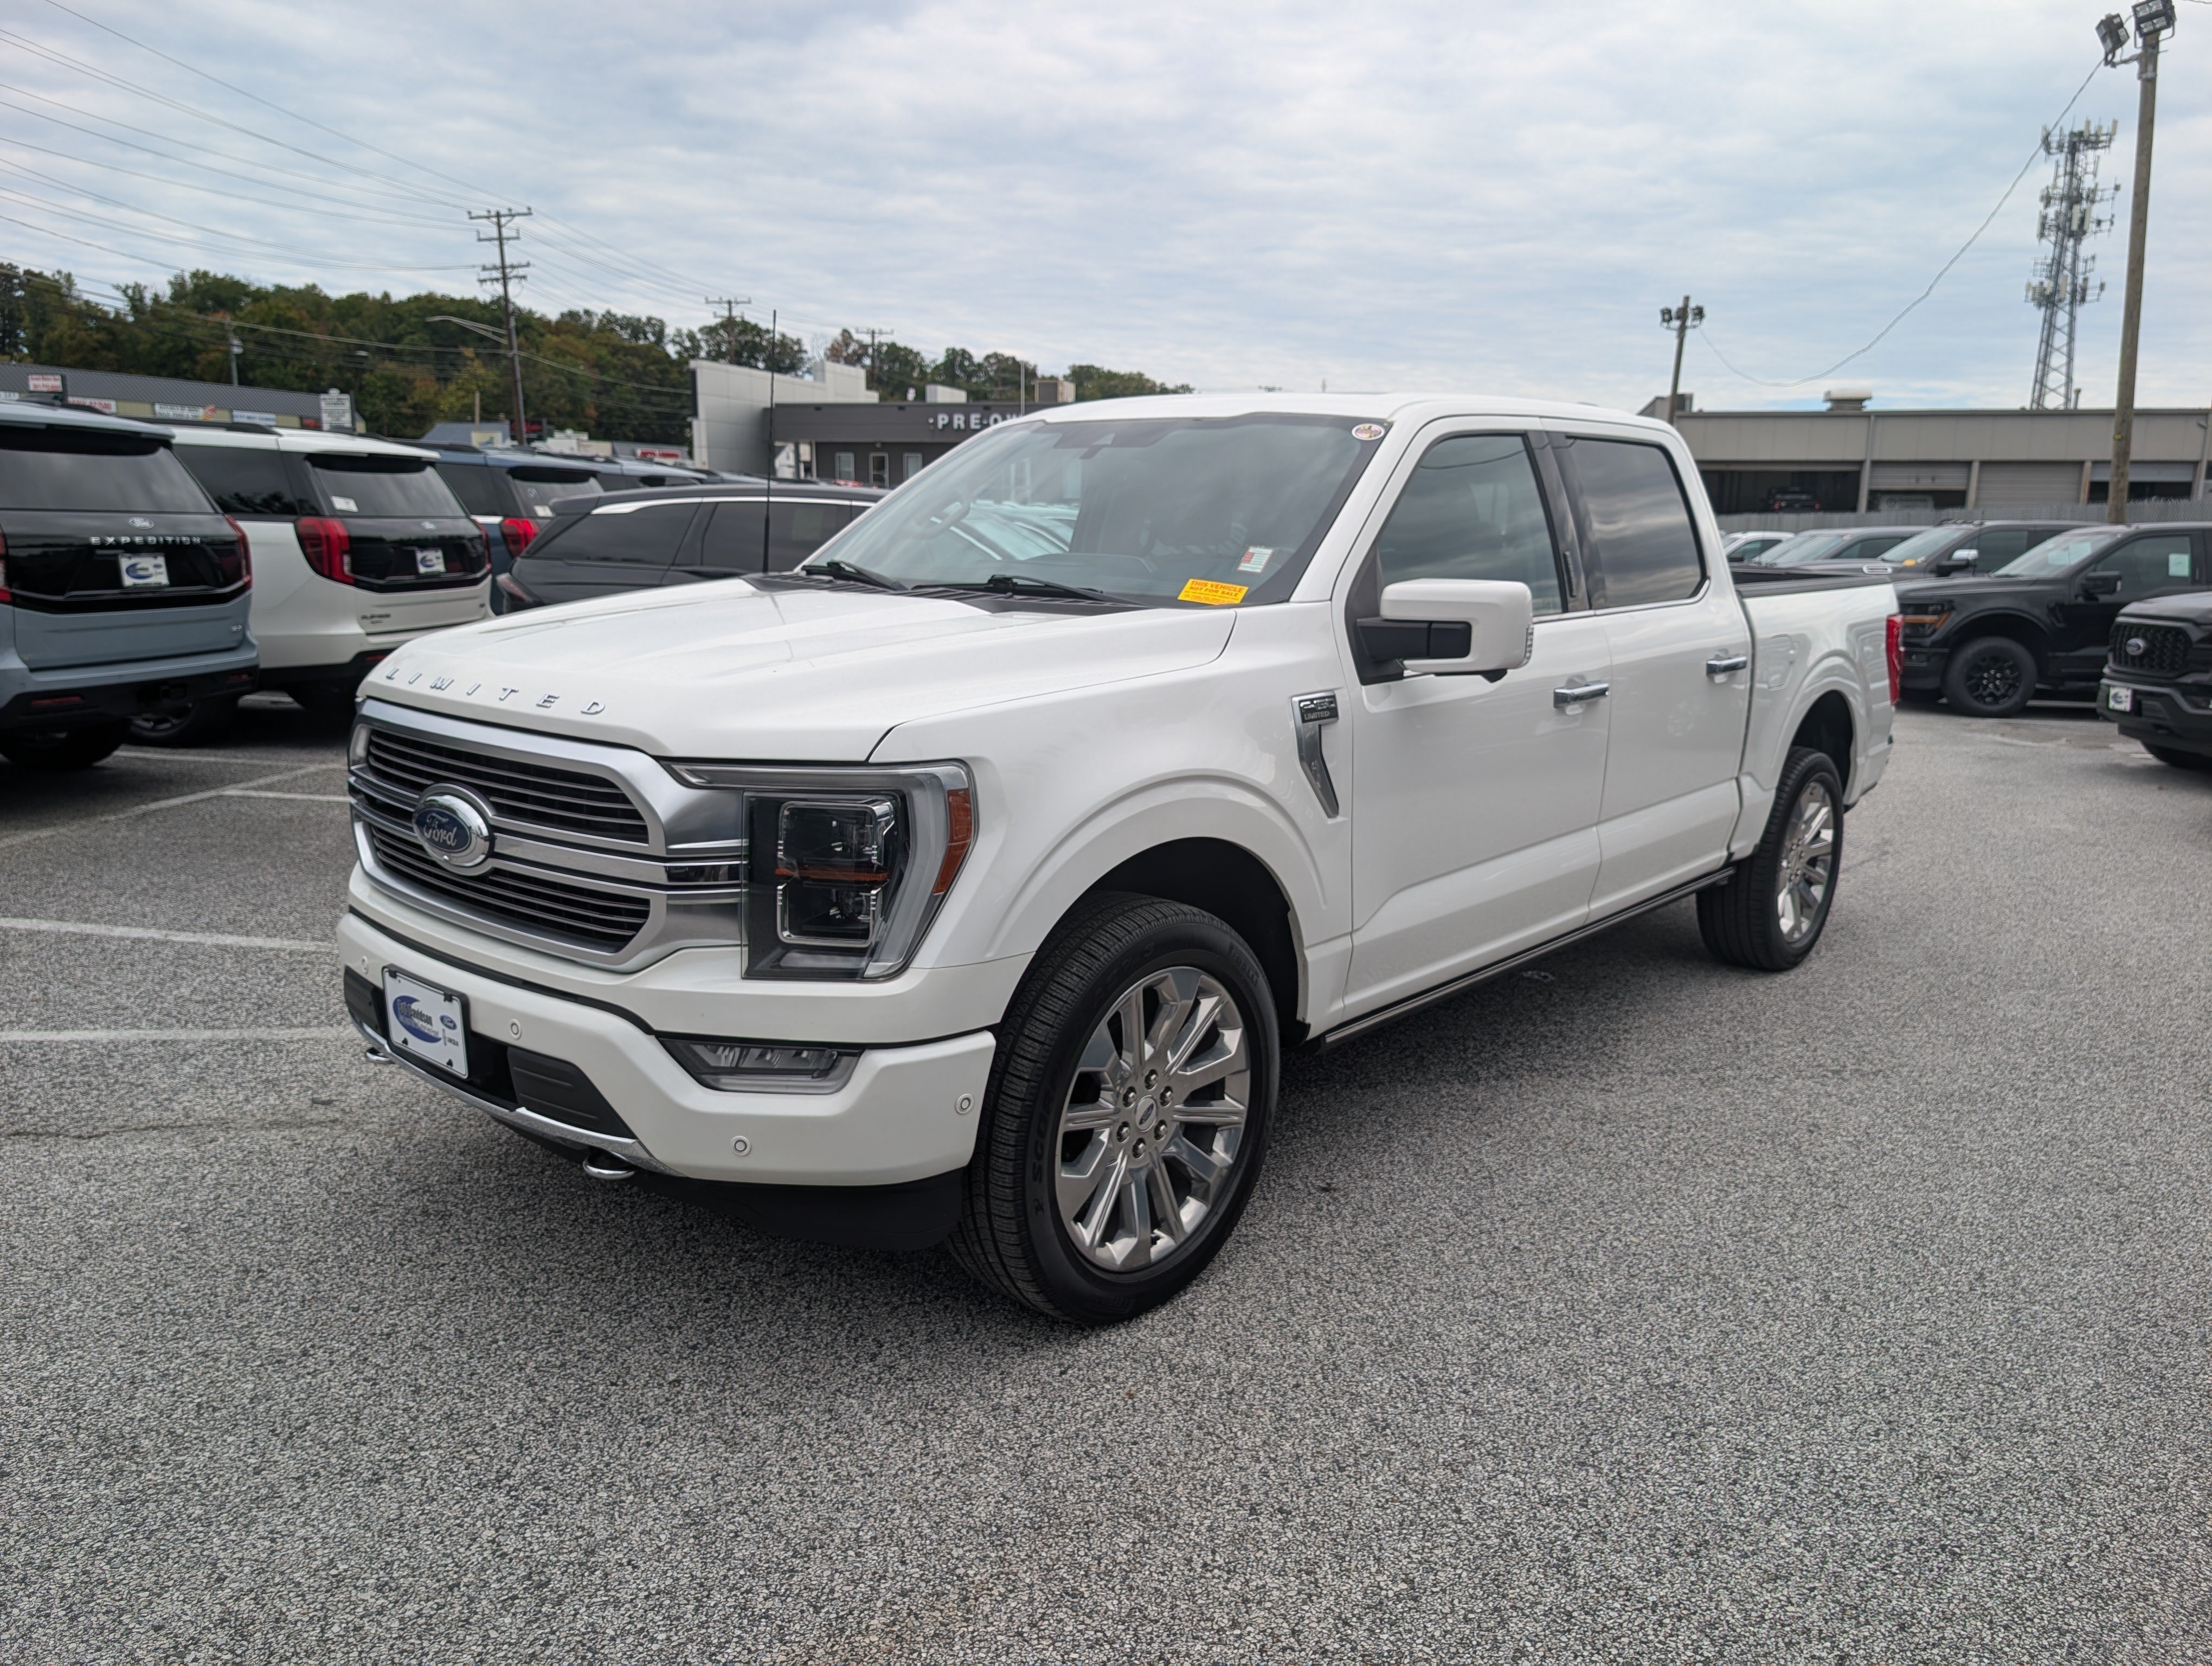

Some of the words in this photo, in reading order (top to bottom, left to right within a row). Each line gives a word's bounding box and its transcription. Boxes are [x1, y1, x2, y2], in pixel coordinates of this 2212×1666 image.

[90, 536, 201, 546] EXPEDITION
[1210, 583, 1244, 593] VEHICLE
[385, 667, 606, 716] LIMITED
[1303, 710, 1330, 720] LIMITED
[423, 812, 458, 847] Ford
